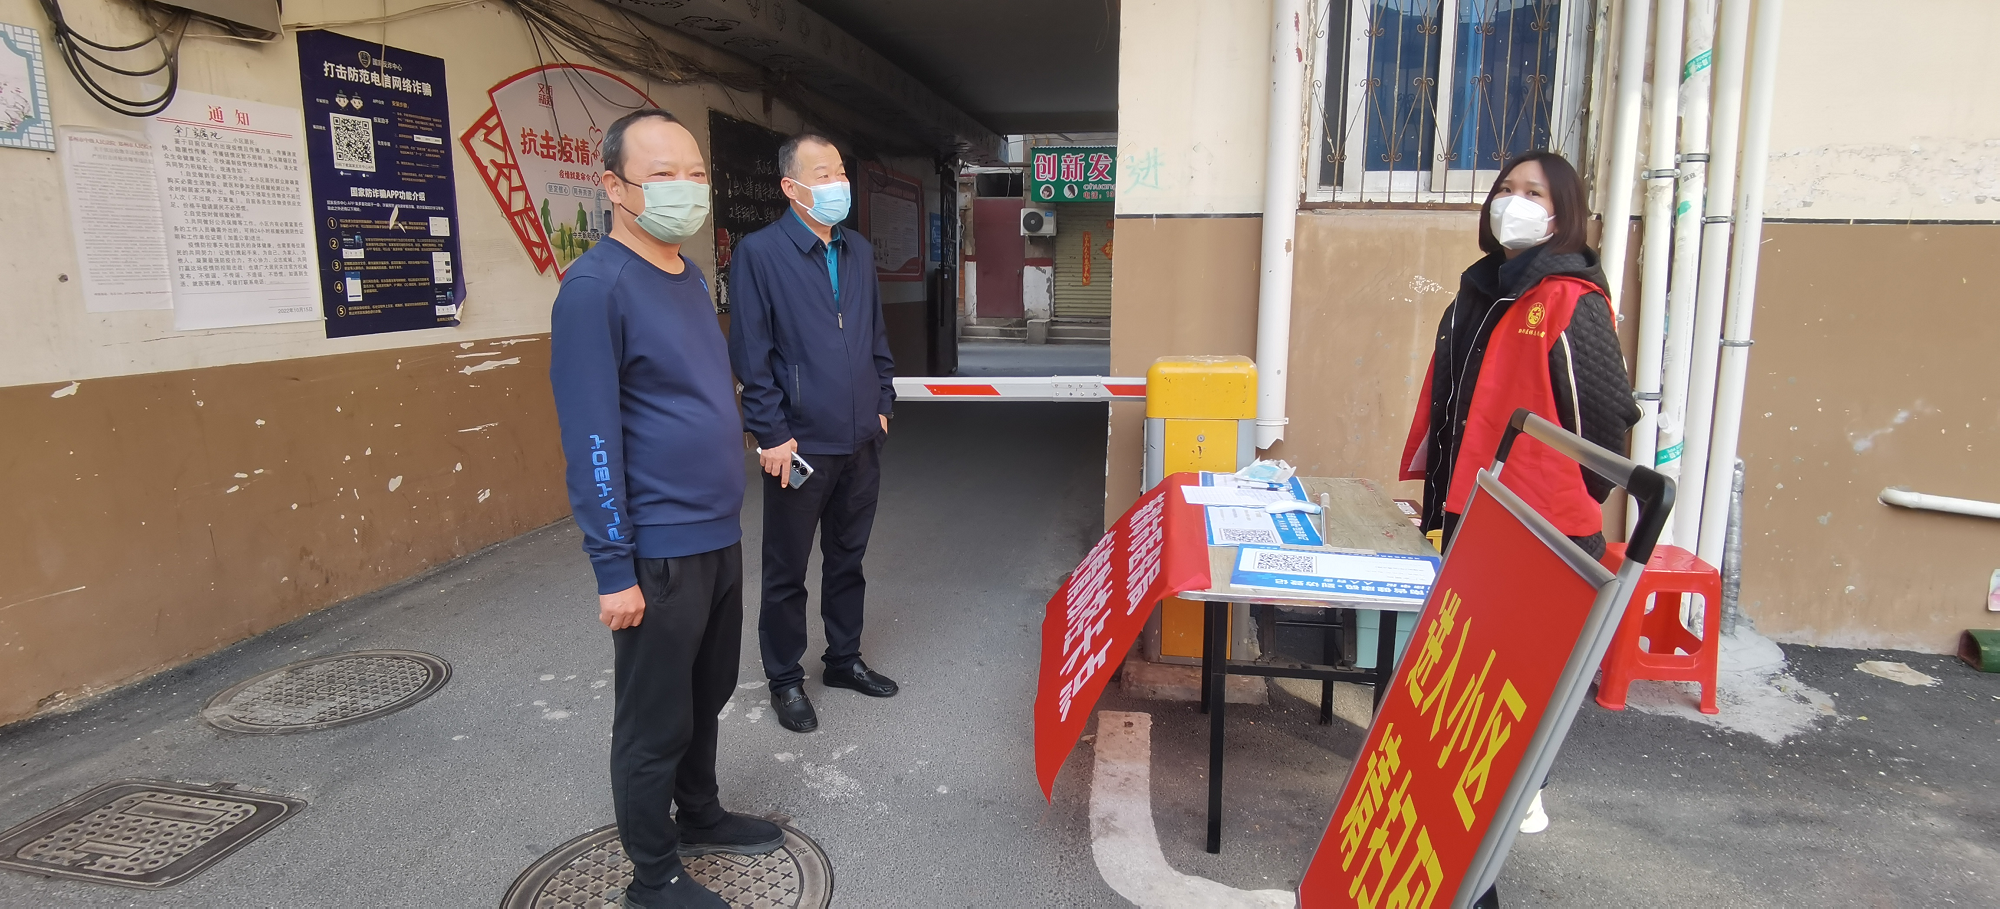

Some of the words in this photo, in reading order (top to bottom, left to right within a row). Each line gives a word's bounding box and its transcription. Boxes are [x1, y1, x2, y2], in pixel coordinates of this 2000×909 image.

[323, 60, 433, 97] 打击防范电信网络诈骗
[520, 127, 590, 166] 抗击疫情
[1034, 153, 1118, 182] 创新发
[589, 434, 625, 542] PLAYBOY
[1126, 491, 1166, 616] 新郑市医保局
[1275, 578, 1430, 595] 南省健康码·到访登记
[1059, 530, 1117, 722] 疫情防控卡点
[1405, 587, 1528, 832] 进入小区
